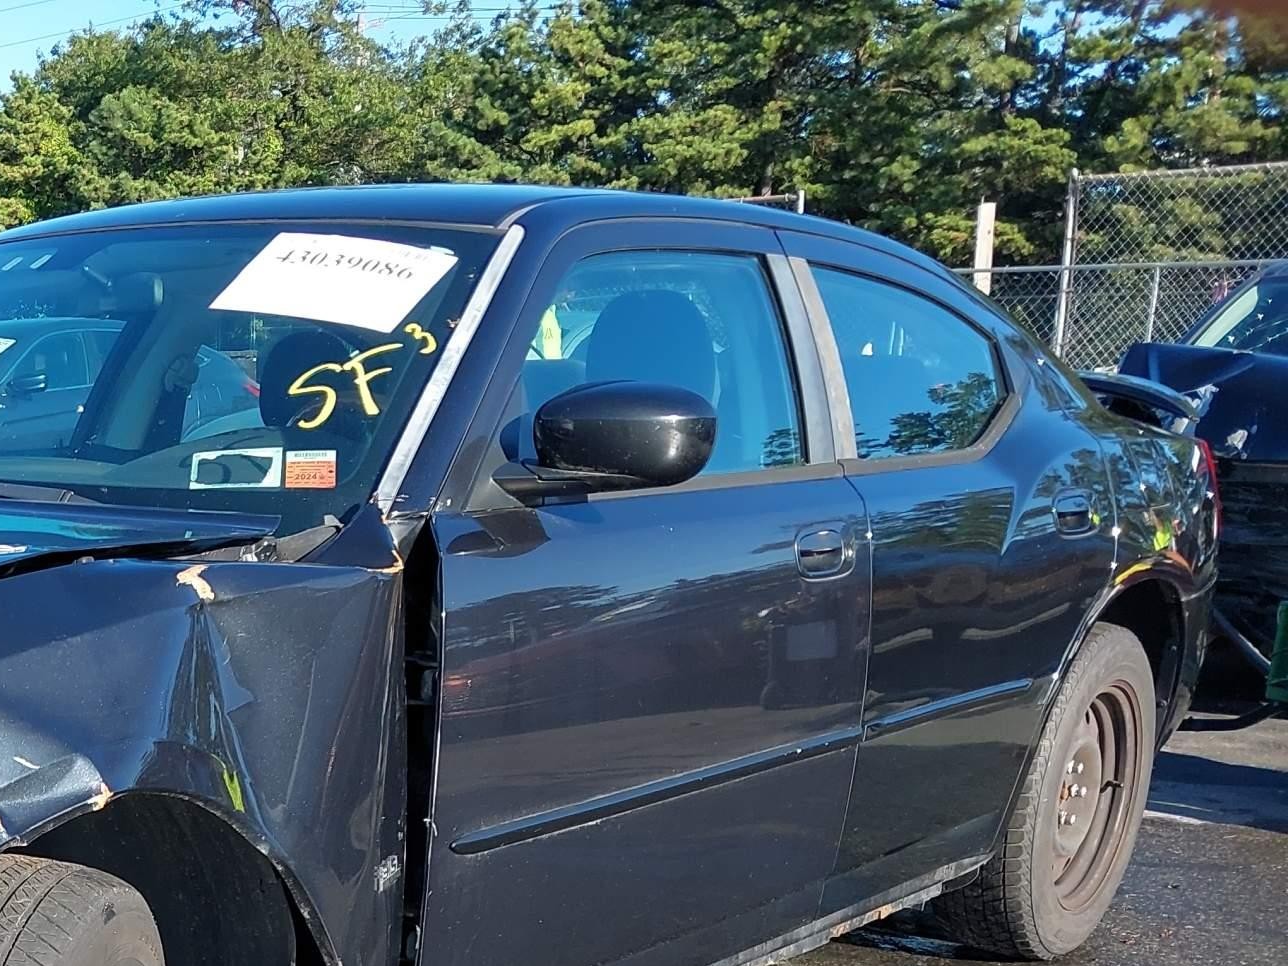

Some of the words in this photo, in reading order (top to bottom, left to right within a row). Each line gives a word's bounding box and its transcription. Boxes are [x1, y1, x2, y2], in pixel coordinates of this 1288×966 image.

[276, 249, 414, 280] 43039086
[287, 342, 405, 429] SF
[403, 322, 438, 355] 3
